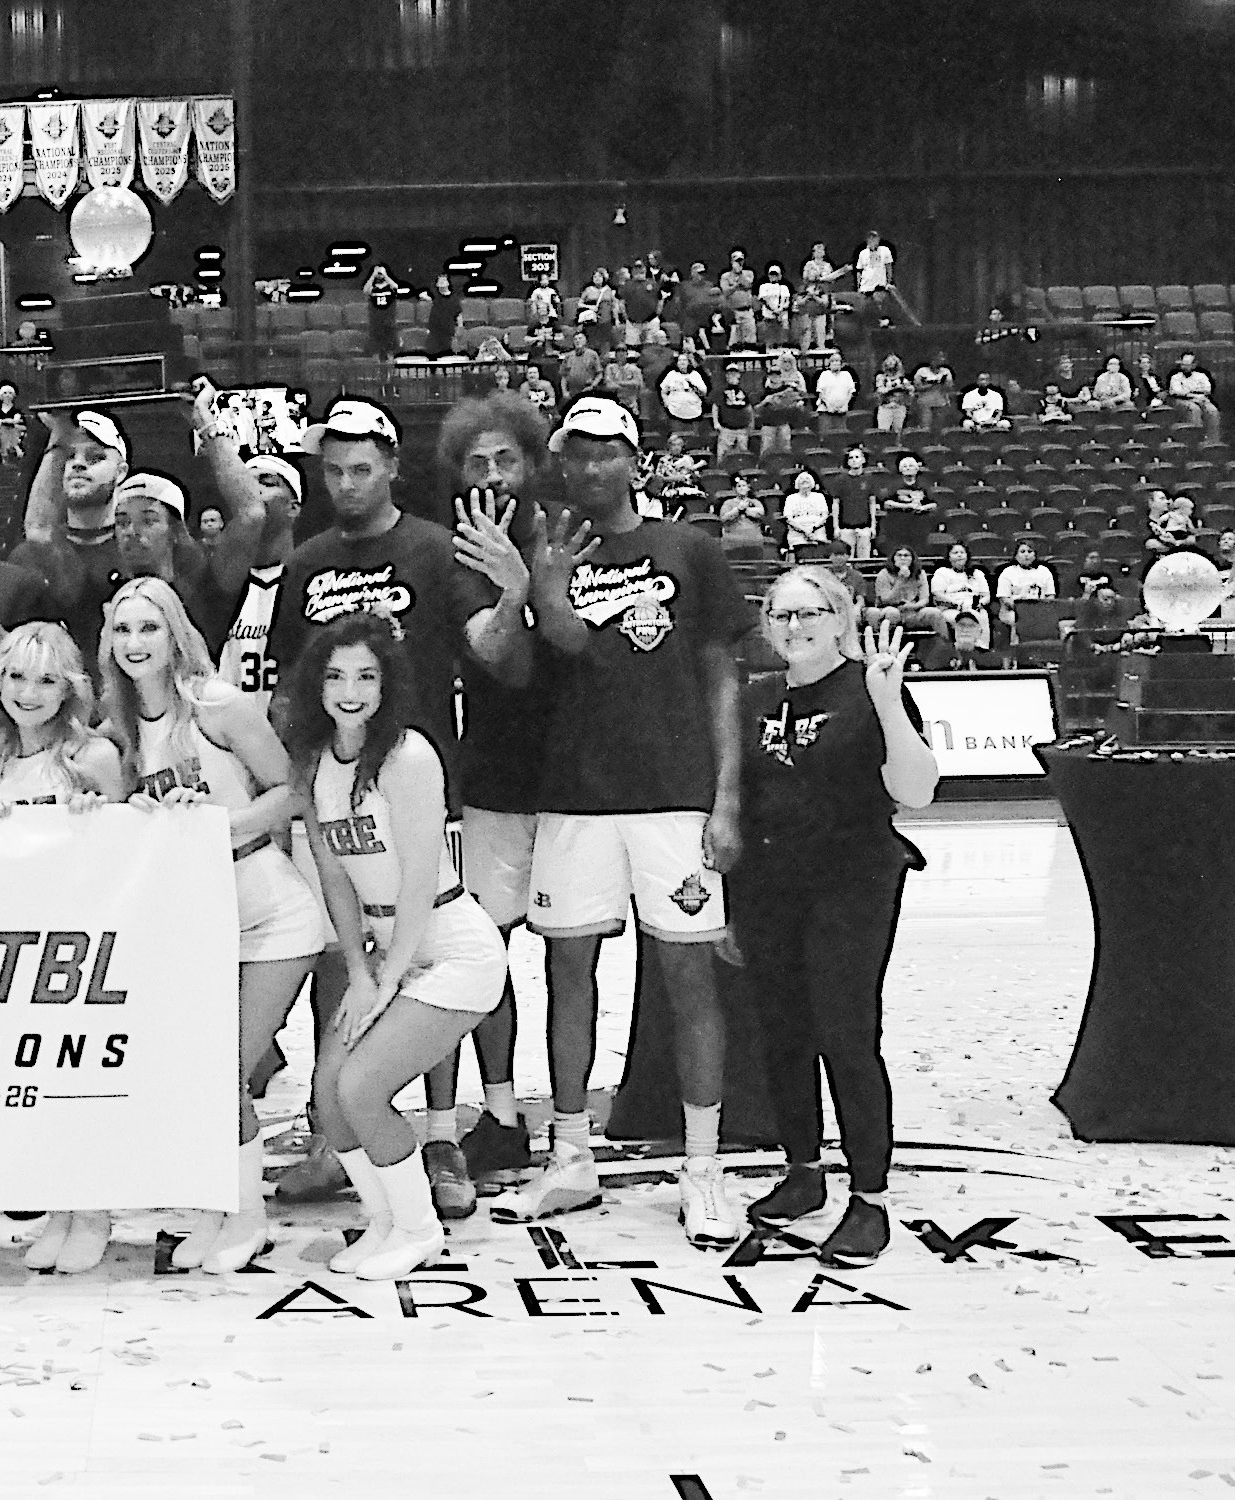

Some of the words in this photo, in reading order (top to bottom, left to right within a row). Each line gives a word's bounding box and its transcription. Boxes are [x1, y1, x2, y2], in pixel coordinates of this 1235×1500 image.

[199, 141, 234, 151] NATION
[36, 146, 75, 158] NATIONAL
[88, 155, 133, 167] CHAMPIONS
[143, 154, 187, 166] CHAMPIONS
[199, 153, 233, 163] CHAMPIO
[100, 167, 121, 175] 2025
[155, 167, 176, 176] 2025
[209, 163, 230, 172] 2025
[47, 171, 68, 179] 2024
[523, 253, 555, 261] SECTION
[531, 262, 550, 271] 203
[241, 651, 280, 693] 32
[965, 735, 1033, 750] BANK
[255, 1273, 912, 1319] ARENA
